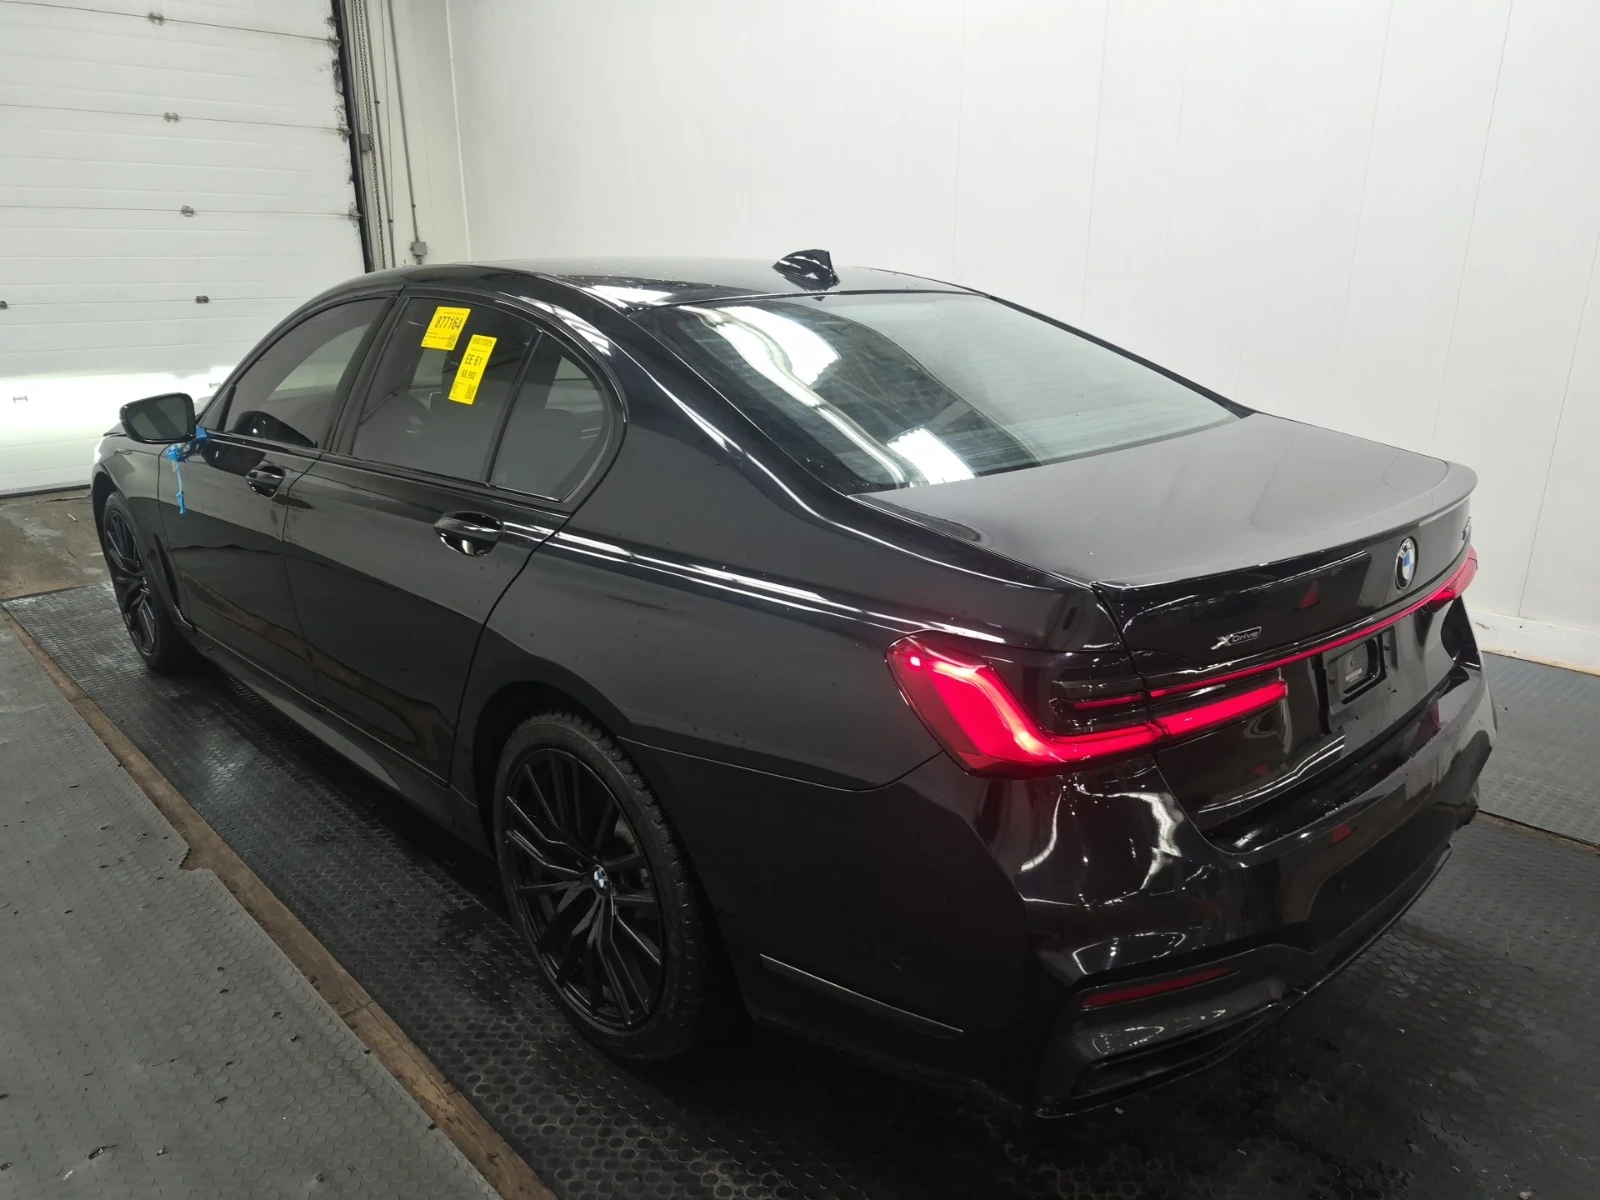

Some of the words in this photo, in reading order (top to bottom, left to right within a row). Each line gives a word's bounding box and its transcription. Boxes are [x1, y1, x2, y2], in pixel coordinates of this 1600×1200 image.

[434, 315, 463, 331] 877164
[465, 353, 475, 365] EE
[473, 355, 483, 367] 61
